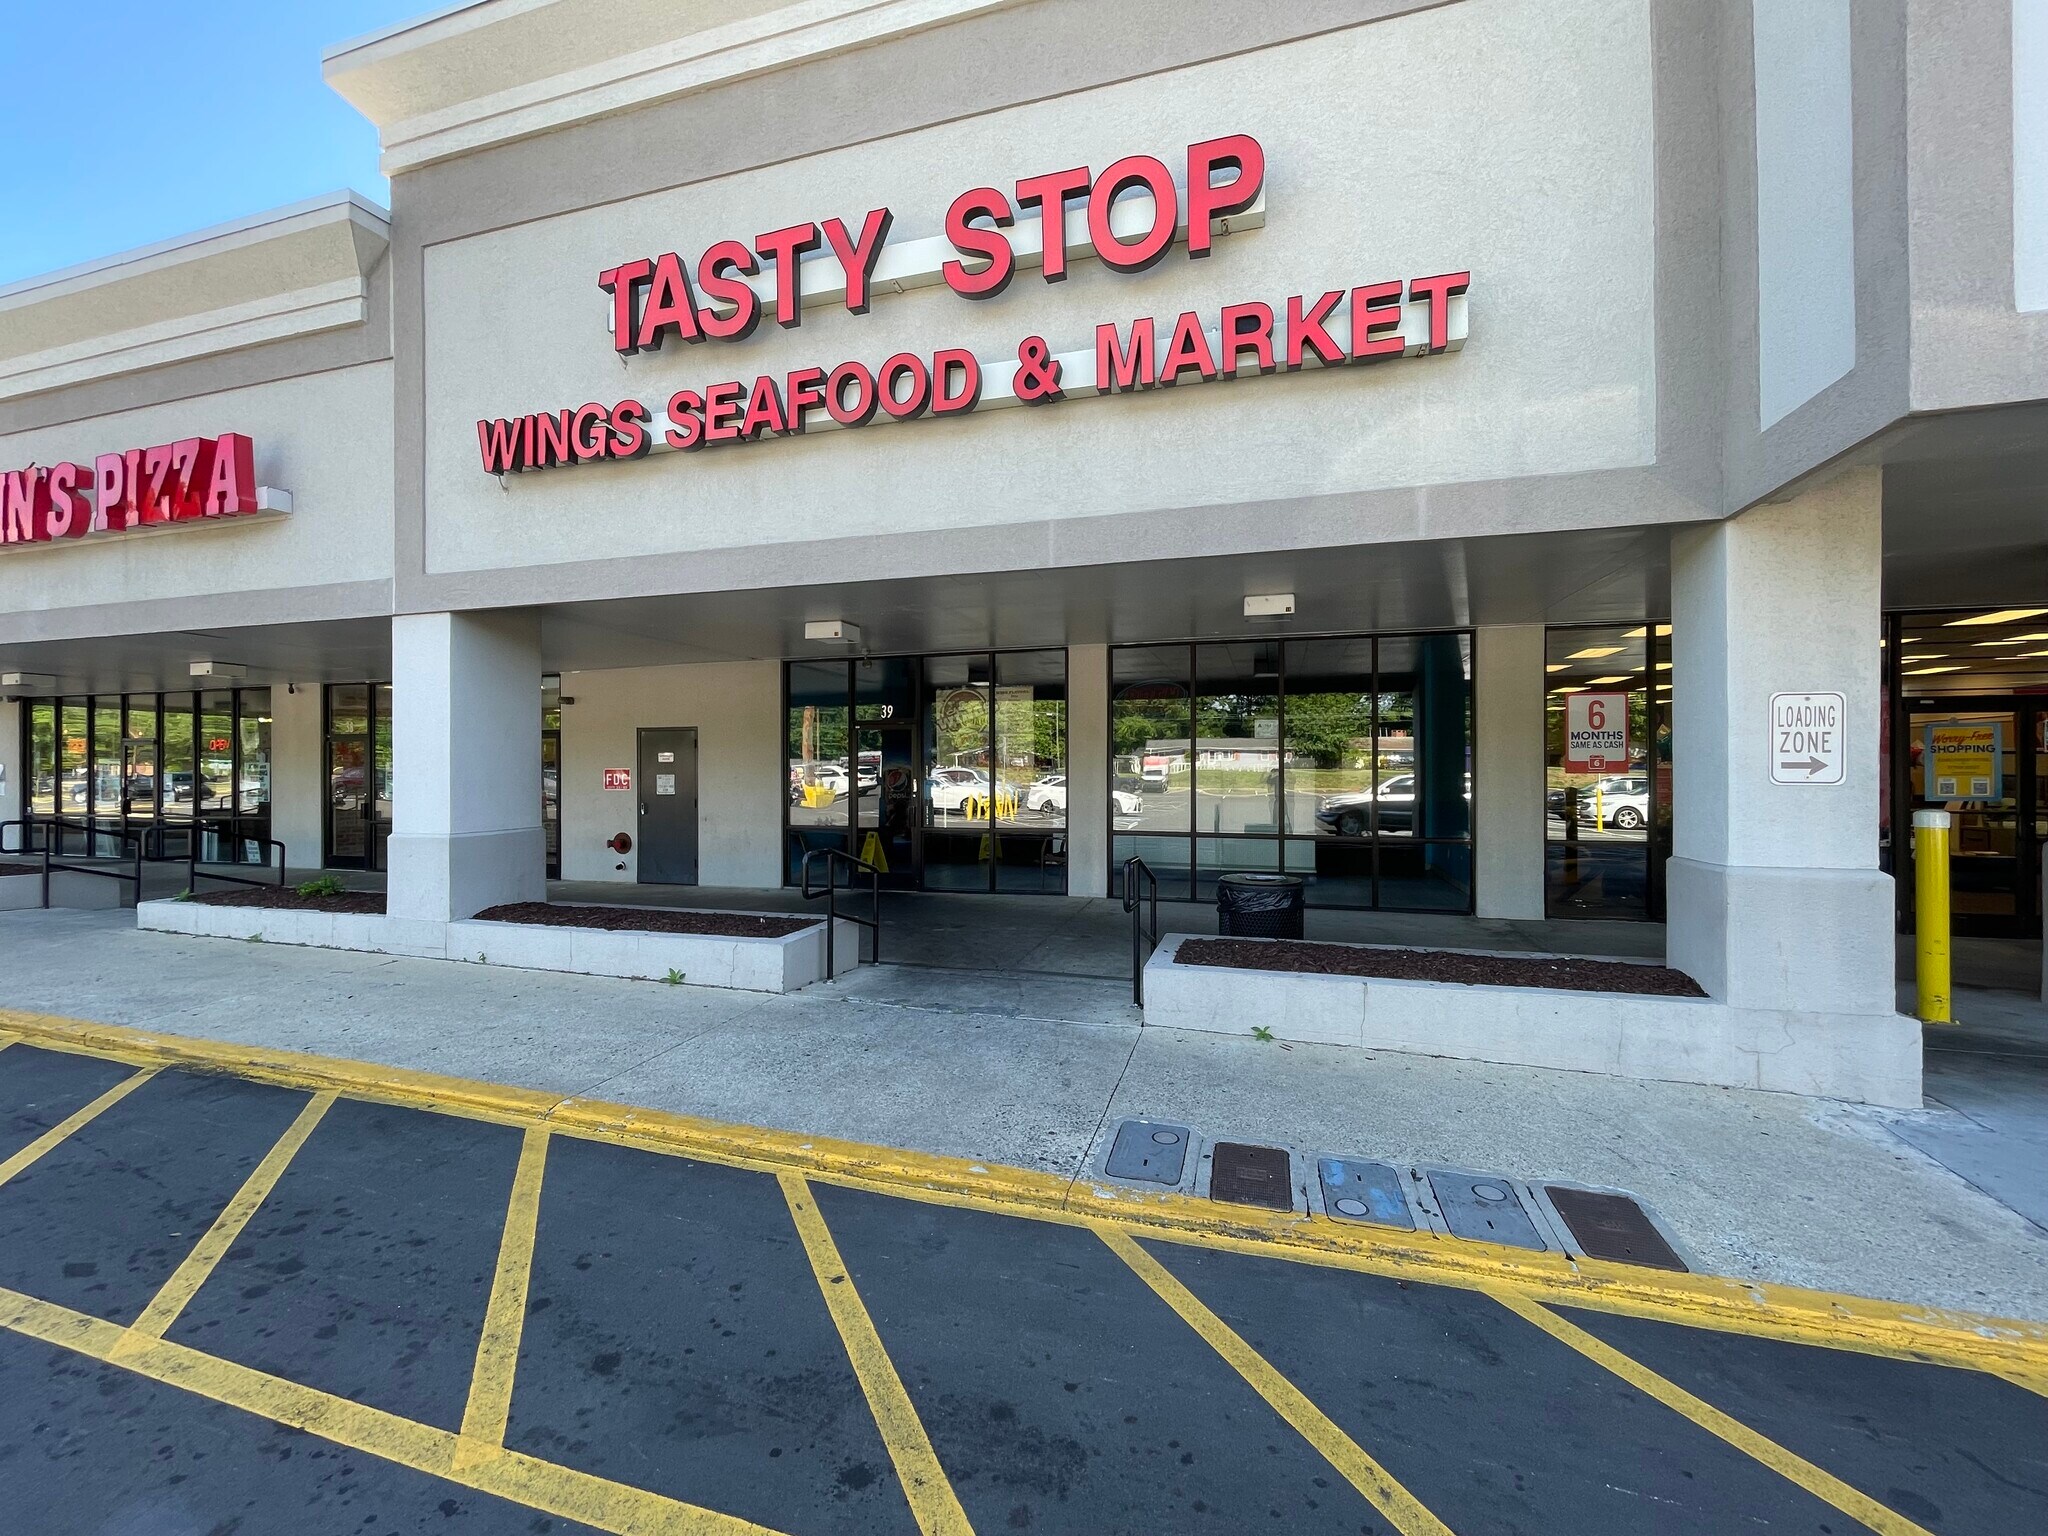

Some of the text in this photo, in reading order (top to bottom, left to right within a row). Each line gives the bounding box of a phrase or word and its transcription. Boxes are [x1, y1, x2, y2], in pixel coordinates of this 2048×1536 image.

[598, 134, 1265, 356] TASTY STOP
[477, 271, 1470, 476] WINGS SEAFOOD & MARKET
[95, 432, 258, 533] PIZZA
[880, 704, 894, 719] 39
[1588, 699, 1606, 731] 6
[1777, 705, 1836, 728] LOADING
[1570, 730, 1624, 740] MONTHS
[1779, 731, 1832, 753] ZONE
[1570, 740, 1624, 749] SAME AS CASH
[1930, 744, 1996, 754] SHOPPING
[1593, 759, 1601, 767] 6
[606, 773, 628, 786] FDC
